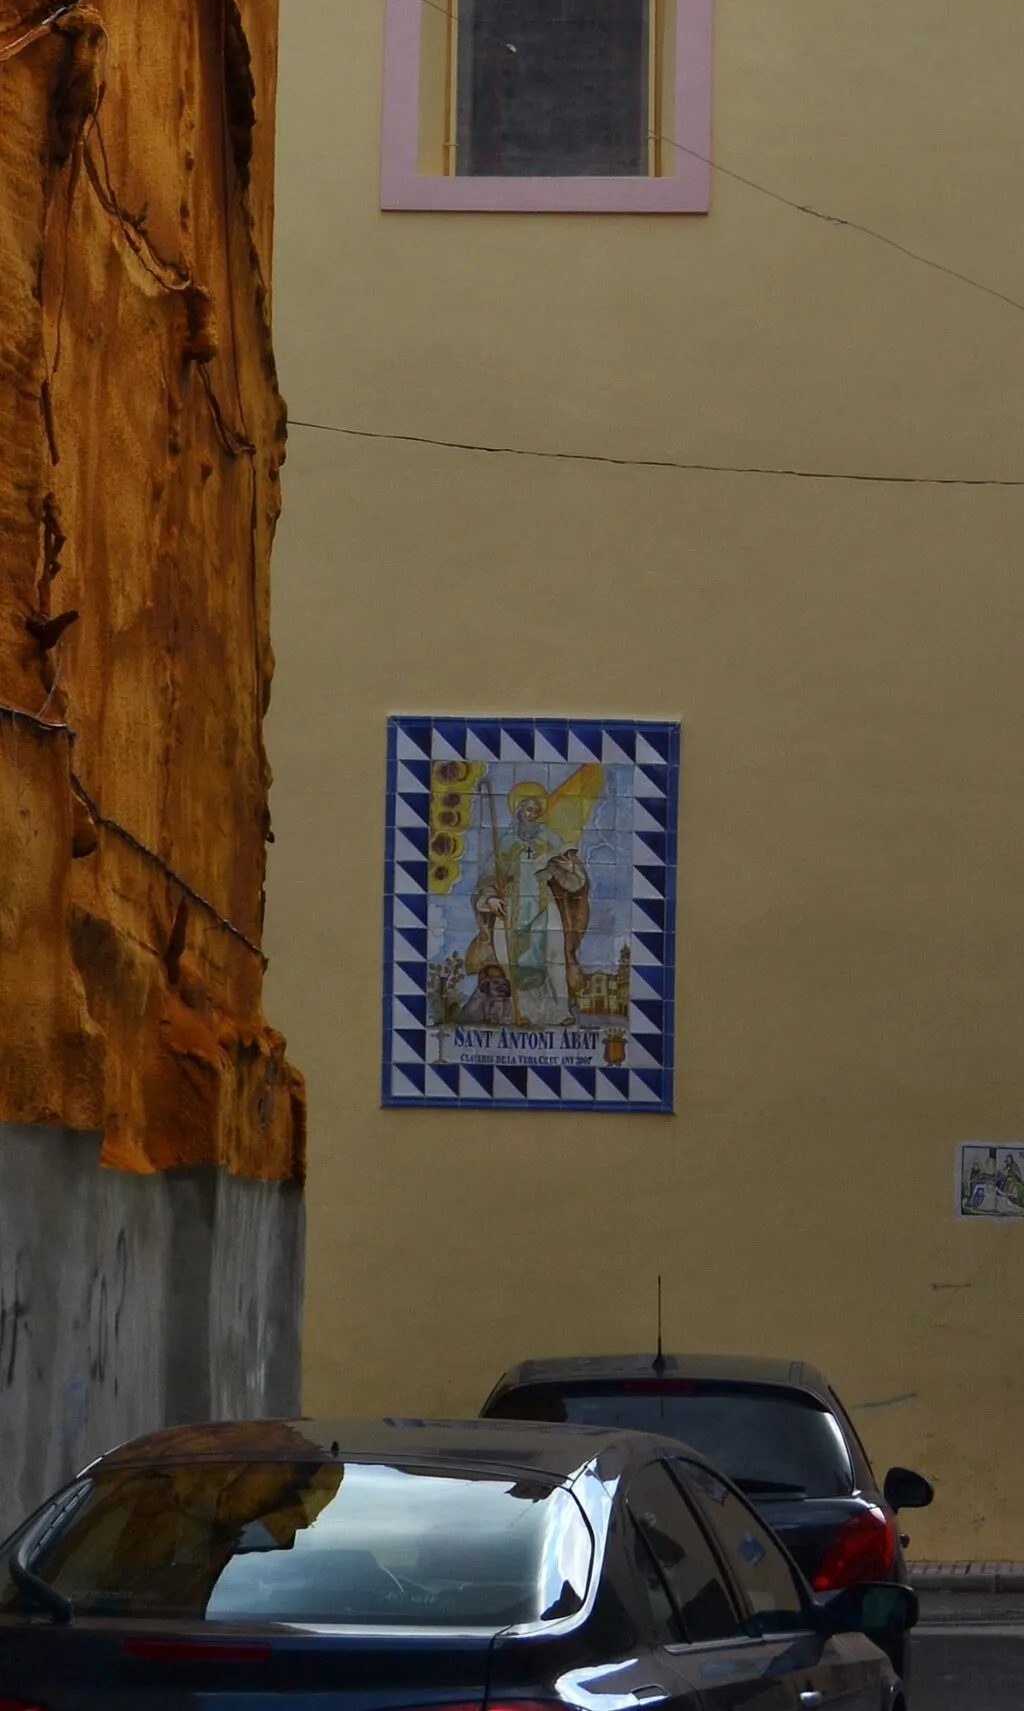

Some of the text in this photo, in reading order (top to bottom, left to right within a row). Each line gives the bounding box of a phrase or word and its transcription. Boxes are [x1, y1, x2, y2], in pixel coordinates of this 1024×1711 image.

[454, 1027, 599, 1049] SANT ANTONI ABAT
